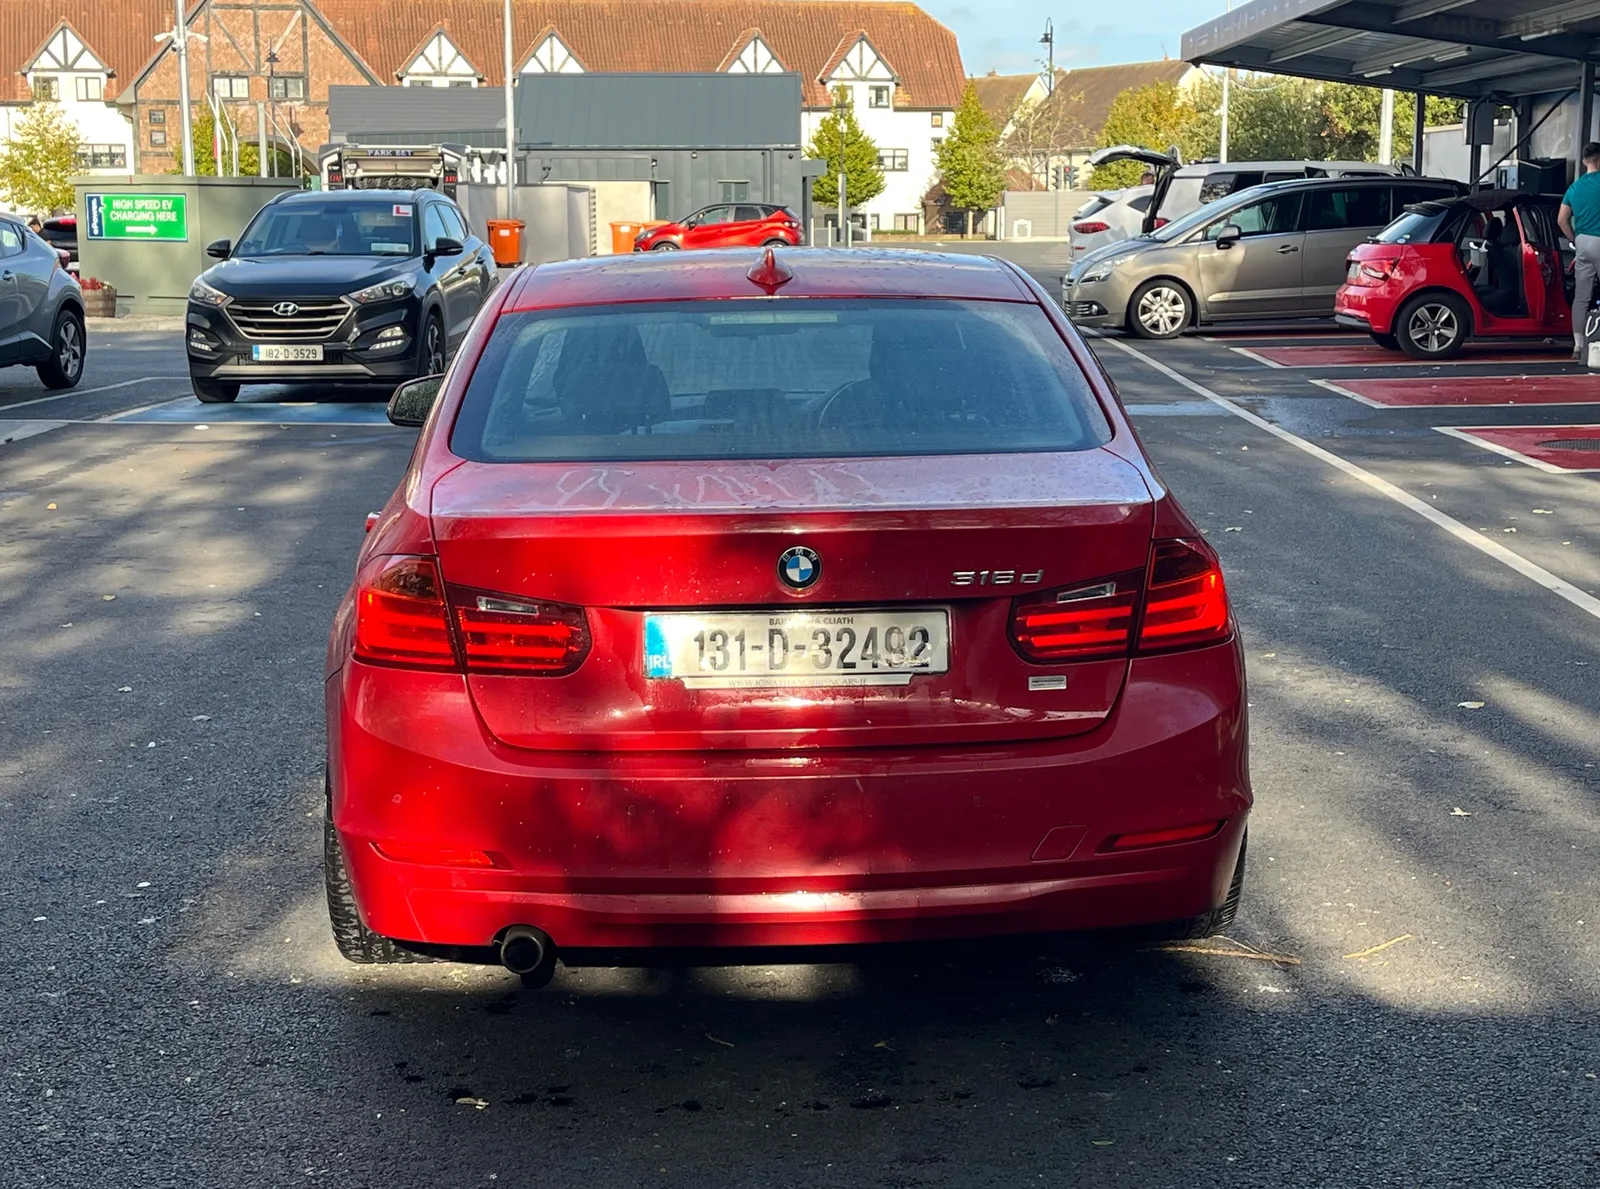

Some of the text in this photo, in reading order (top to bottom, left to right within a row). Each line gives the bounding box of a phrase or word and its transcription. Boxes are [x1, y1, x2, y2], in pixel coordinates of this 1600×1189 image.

[112, 199, 173, 210] HIGH SPEED EV
[110, 211, 178, 222] CHARGING HERE
[265, 348, 317, 359] 182-D-3529
[782, 548, 818, 562] BMW
[823, 616, 854, 625] CLIATH
[694, 626, 930, 669] 131-D-32492
[649, 655, 672, 669] IRL
